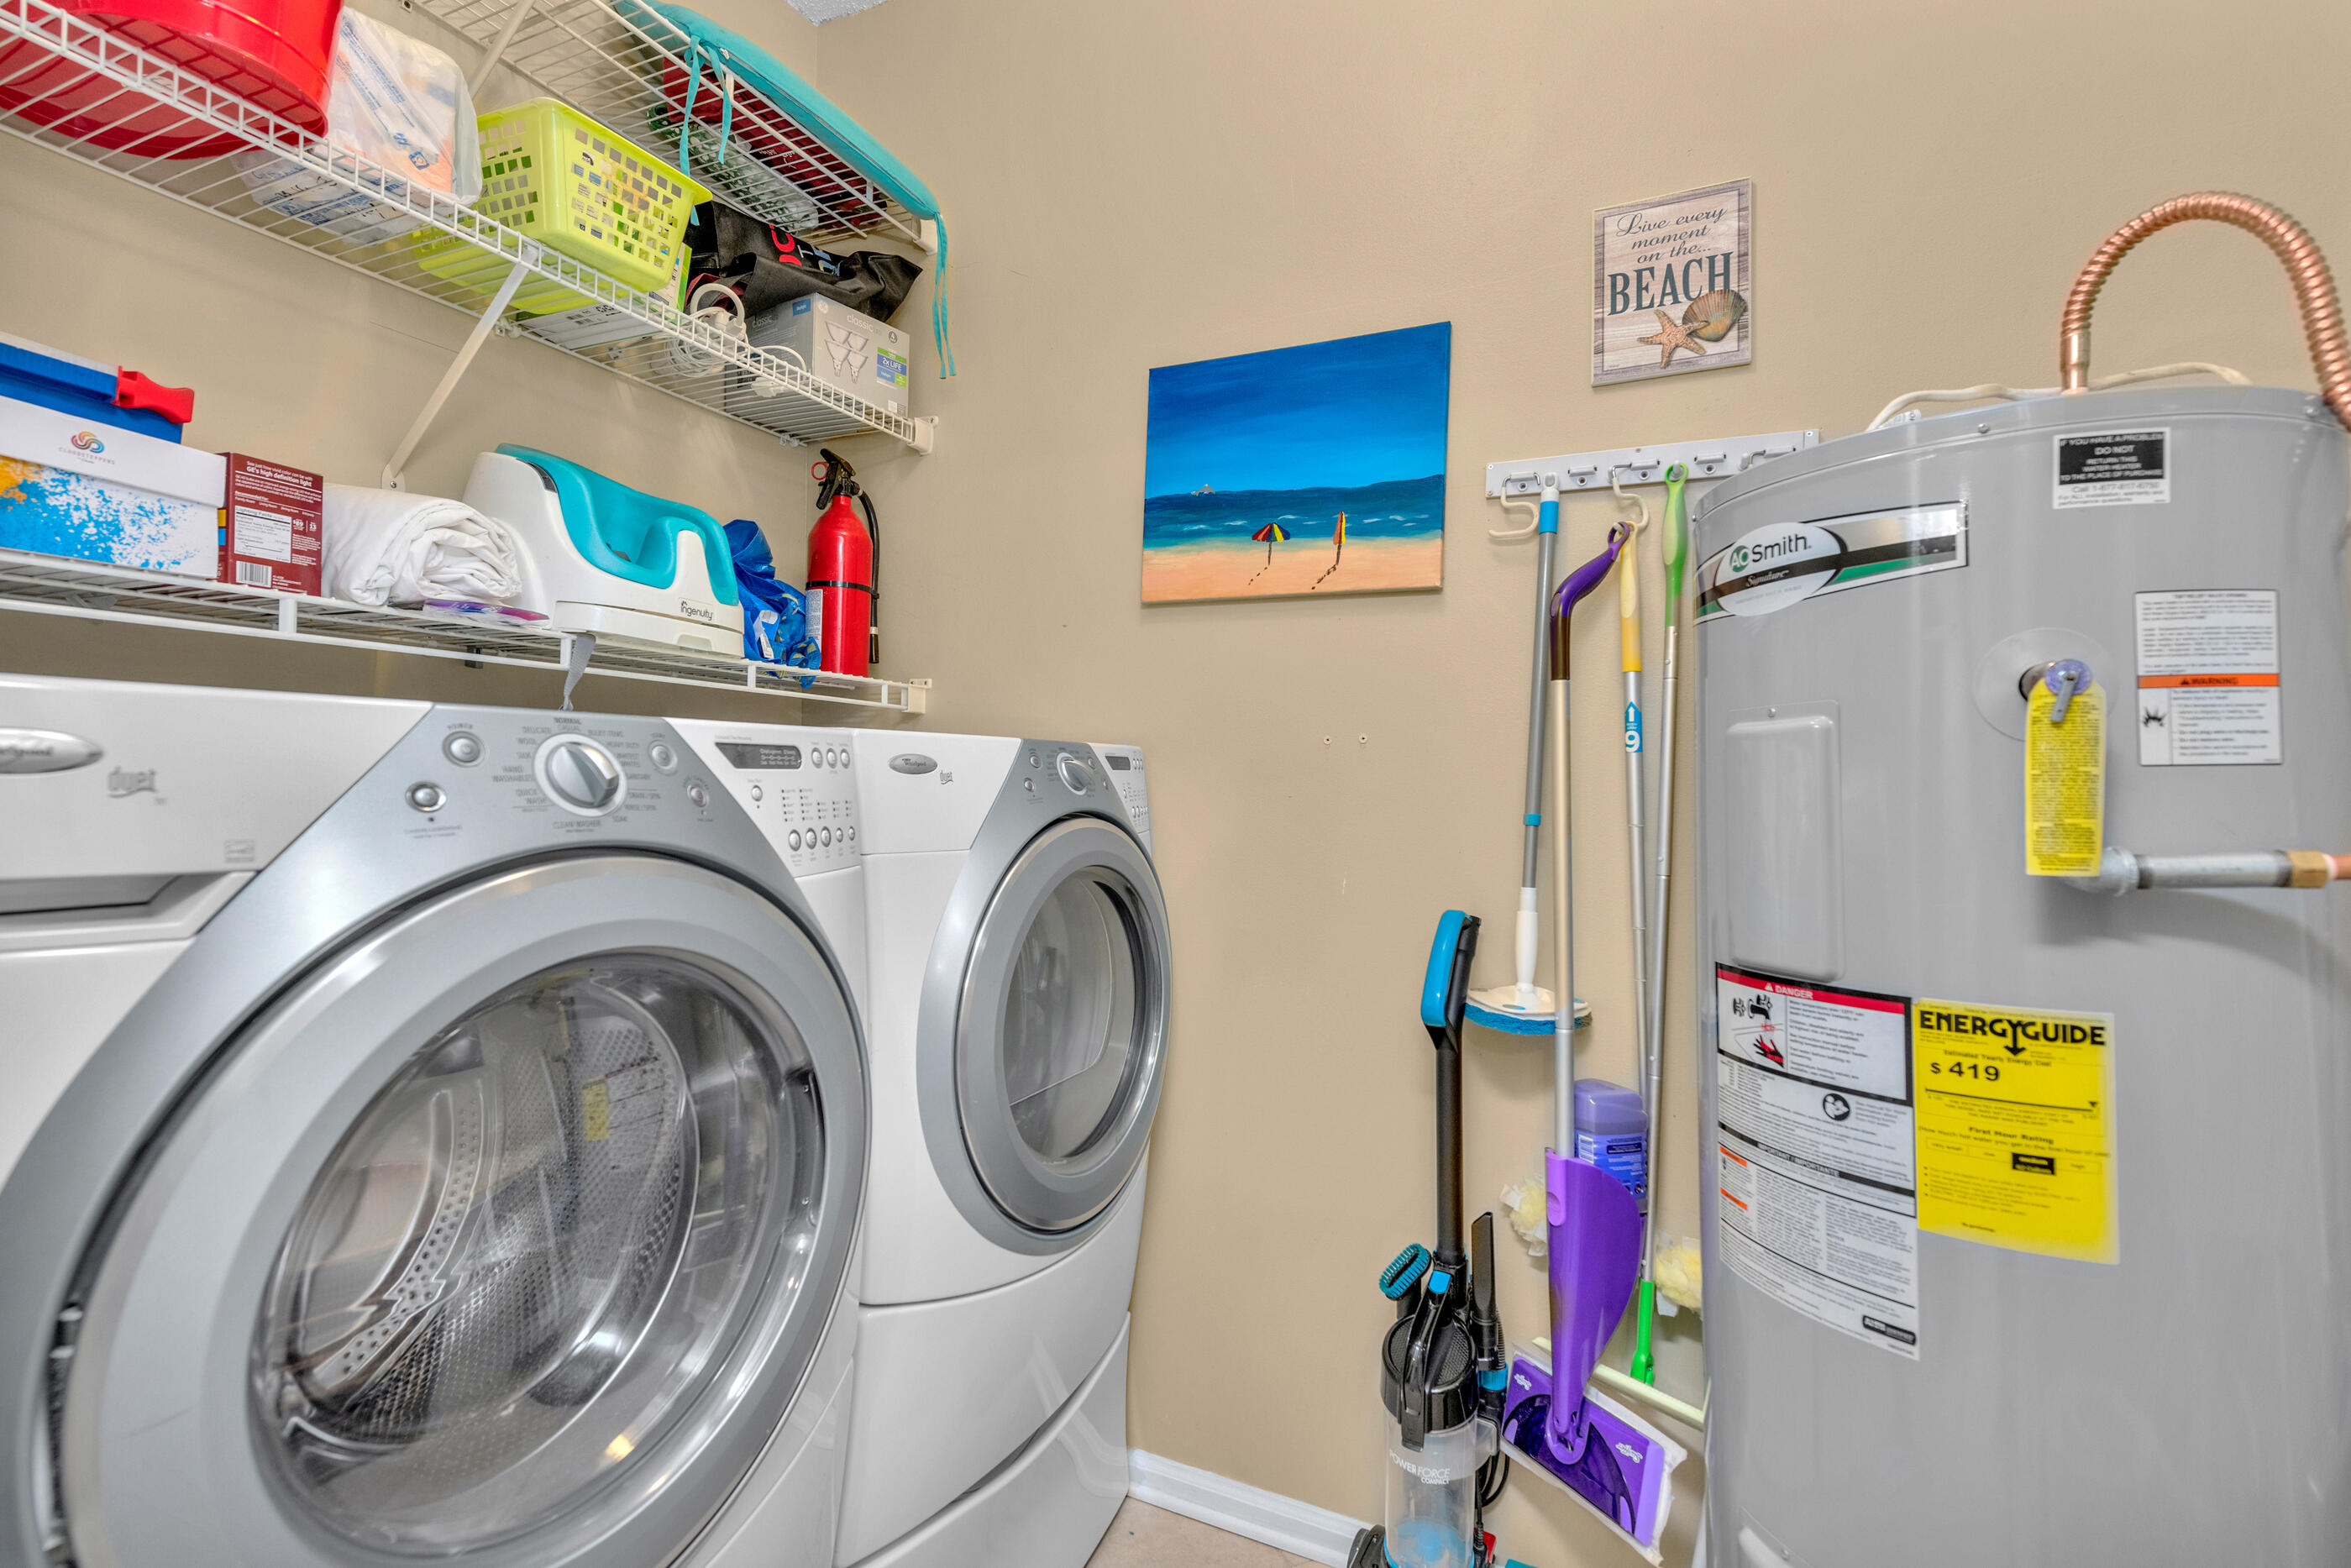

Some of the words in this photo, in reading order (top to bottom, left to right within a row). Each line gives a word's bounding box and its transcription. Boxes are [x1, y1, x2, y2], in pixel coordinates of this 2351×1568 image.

[1615, 212, 1671, 238] Live
[1677, 208, 1727, 226] every
[1632, 225, 1710, 249] moment
[1637, 253, 1665, 264] on
[1670, 240, 1711, 258] the...
[1608, 251, 1734, 316] BEACH
[847, 314, 874, 332] classic
[890, 359, 902, 371] LIFE
[2069, 438, 2089, 446] YOU
[2089, 436, 2114, 444] HAVE
[2094, 446, 2112, 455] DO
[2112, 445, 2136, 454] NOT
[2112, 463, 2142, 471] HEATER
[260, 469, 273, 477] high
[274, 472, 299, 484] definition
[300, 479, 312, 487] light
[236, 506, 258, 516] Lighting
[1751, 533, 1808, 563] Smith
[680, 600, 713, 621] ingenuity
[2191, 677, 2238, 685] WARNING
[1775, 984, 1813, 999] DANGER
[1920, 1010, 2106, 1048] ENERGYGUIDE
[1944, 1049, 1979, 1060] Estimated
[1981, 1053, 2005, 1063] Yearly
[2007, 1056, 2034, 1067] Energy
[1948, 1061, 2000, 1082] 419
[1969, 1126, 1991, 1135] First
[1994, 1130, 2018, 1140] Hour
[2021, 1134, 2055, 1145] Rating
